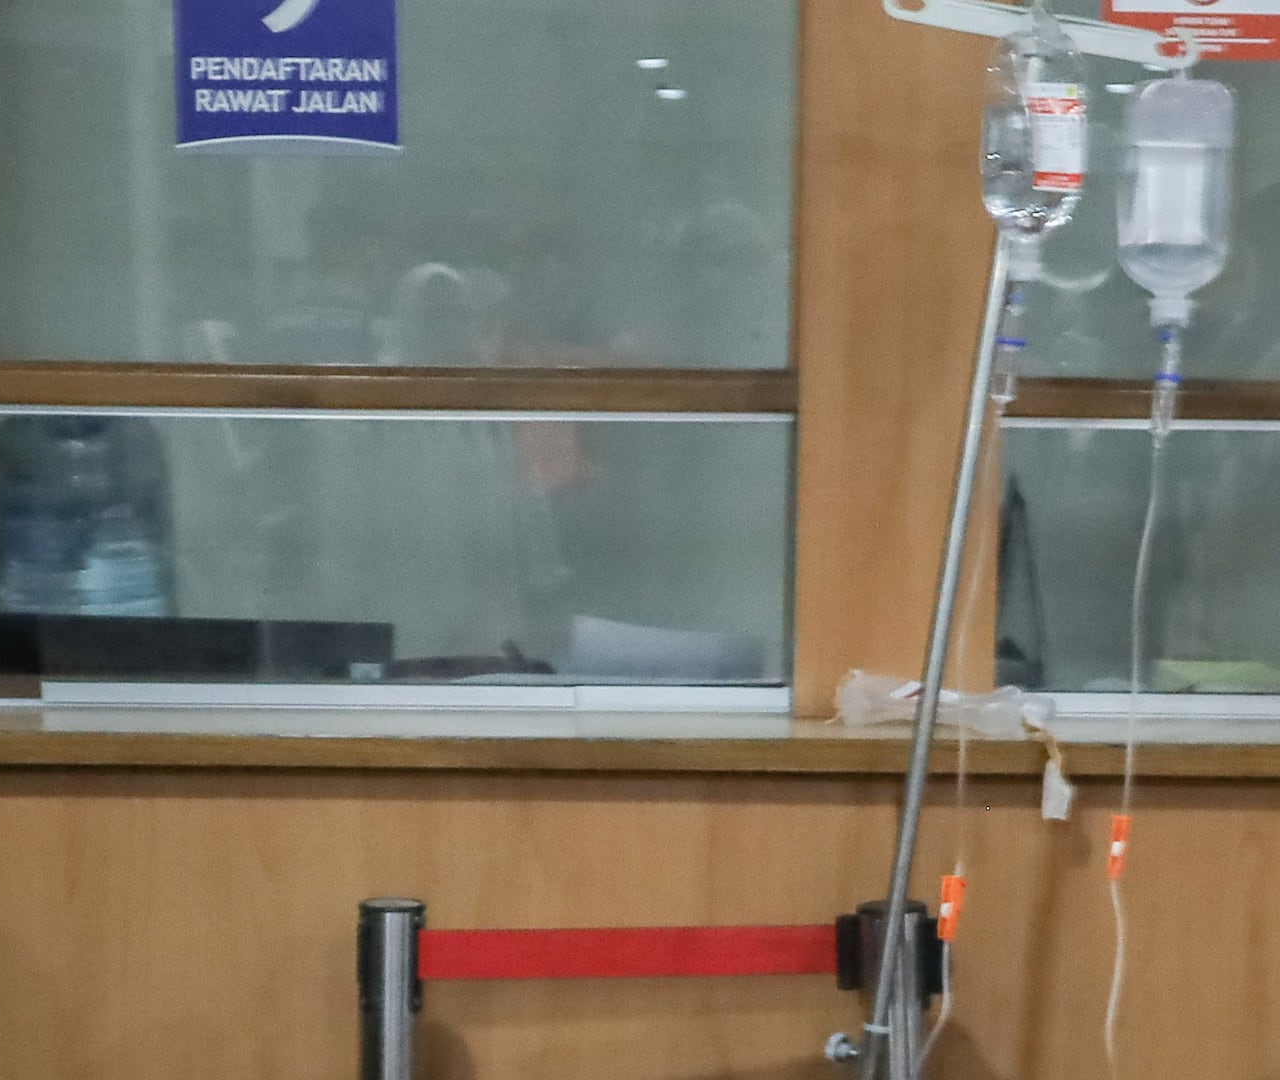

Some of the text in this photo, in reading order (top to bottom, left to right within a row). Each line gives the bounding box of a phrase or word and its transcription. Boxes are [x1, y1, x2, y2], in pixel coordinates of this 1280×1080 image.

[190, 56, 383, 82] PENDAFTARAN
[194, 88, 379, 114] RAWAT JALAN
